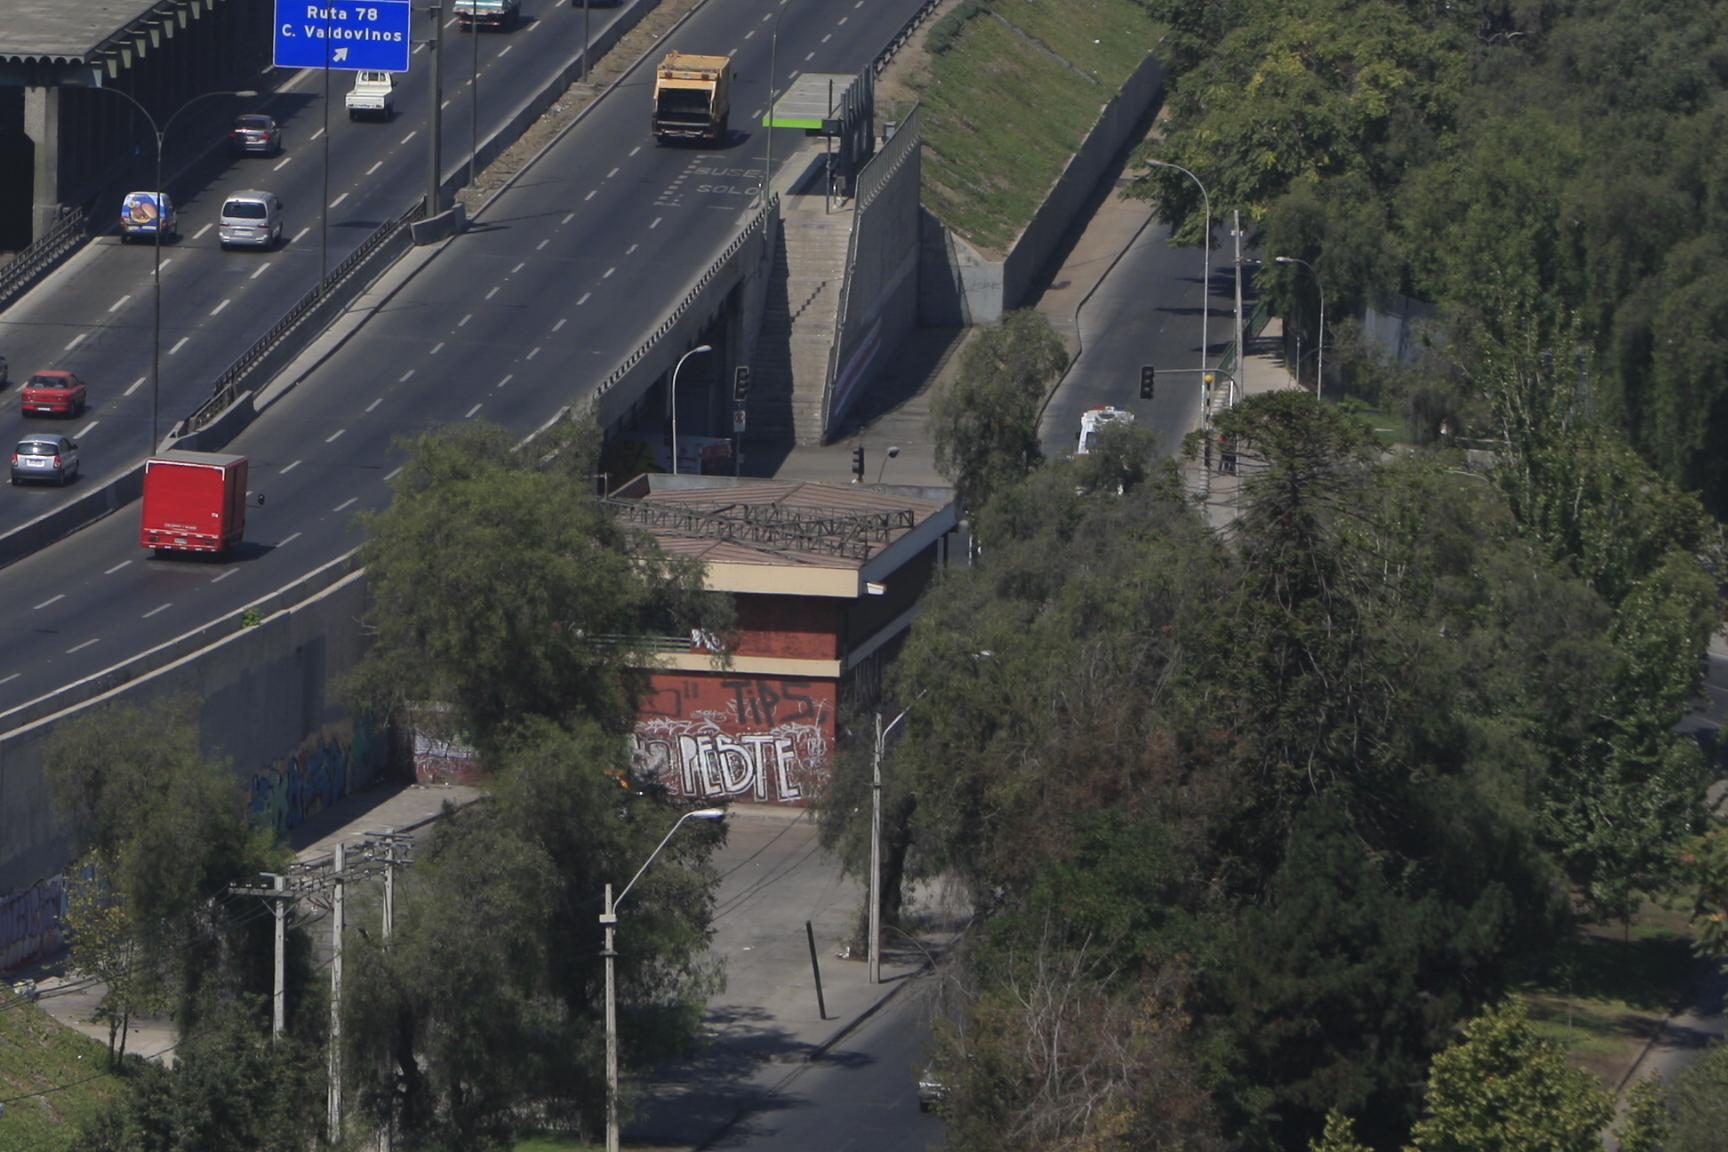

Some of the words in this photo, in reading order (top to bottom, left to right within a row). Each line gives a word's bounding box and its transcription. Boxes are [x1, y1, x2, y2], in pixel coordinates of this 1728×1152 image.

[307, 5, 347, 20] Ruta
[355, 8, 378, 21] 78
[281, 23, 296, 38] C.
[304, 25, 402, 42] Valdovinos
[696, 184, 760, 196] SOLO
